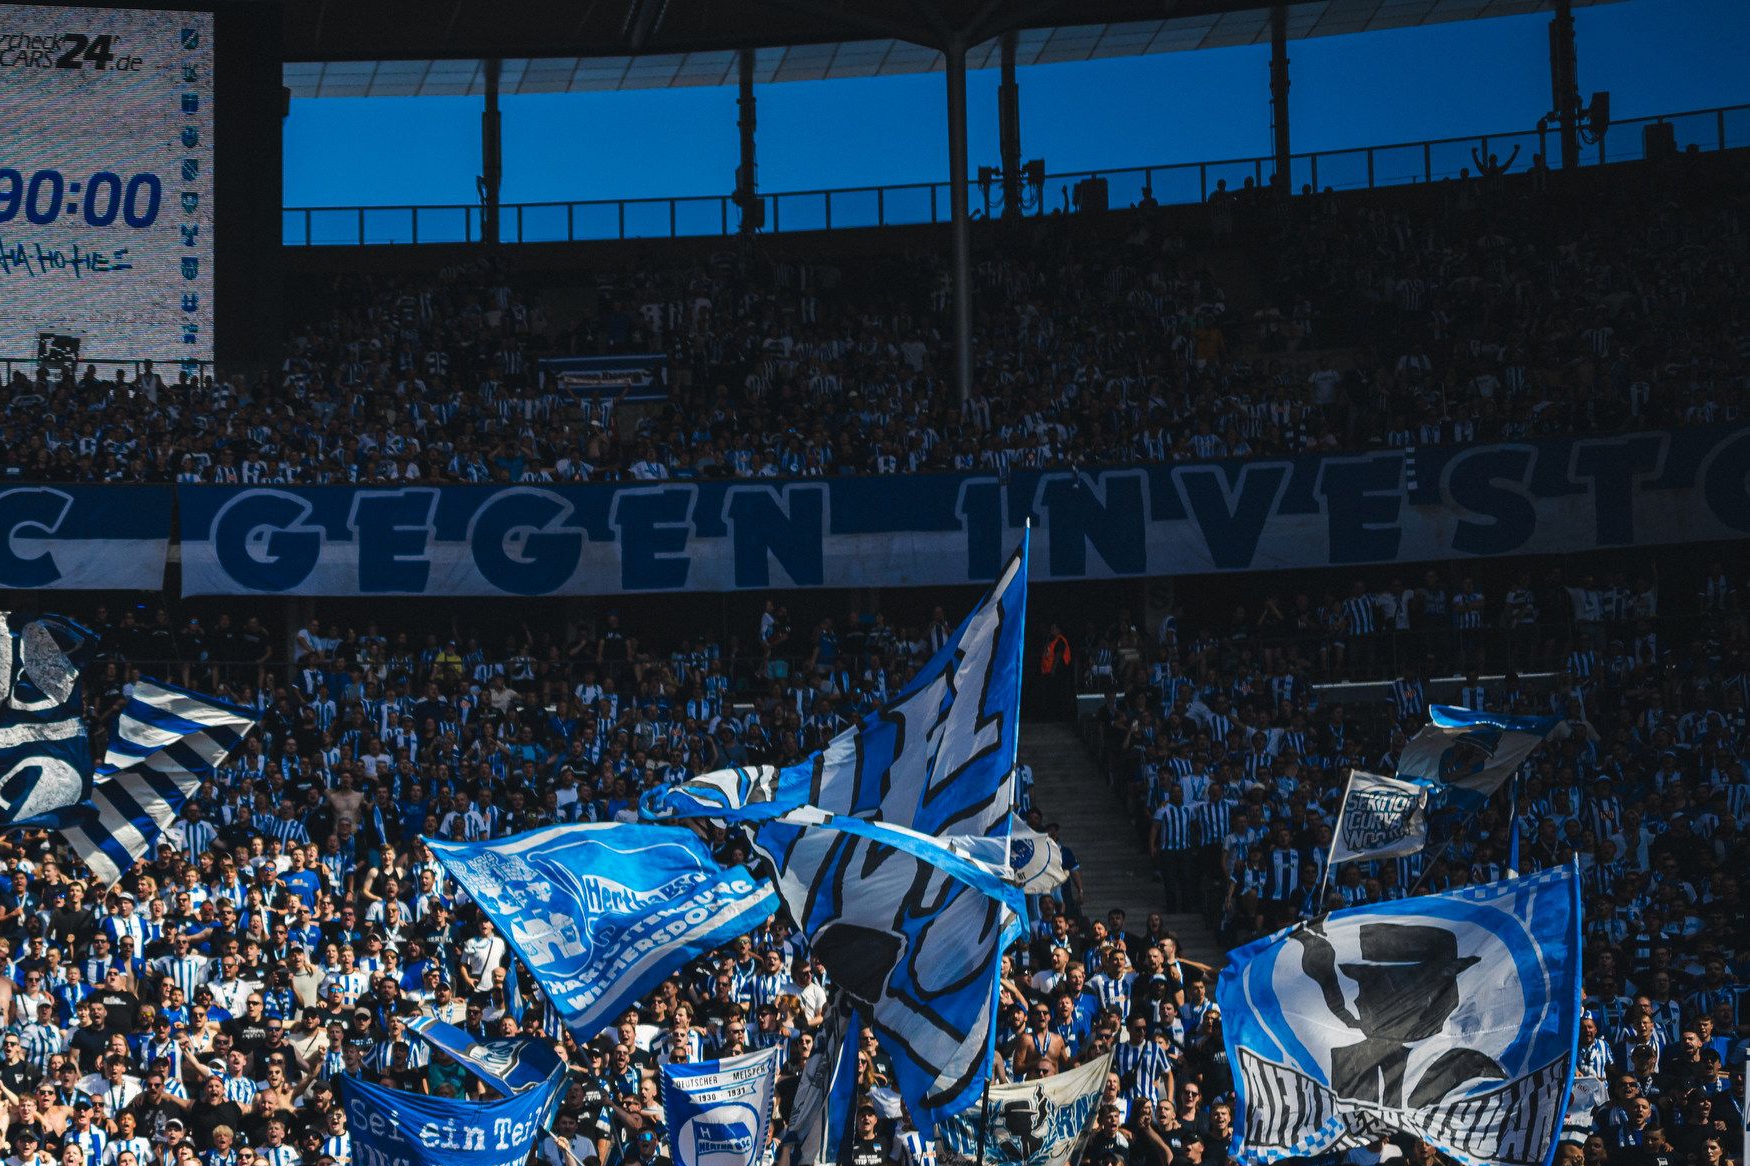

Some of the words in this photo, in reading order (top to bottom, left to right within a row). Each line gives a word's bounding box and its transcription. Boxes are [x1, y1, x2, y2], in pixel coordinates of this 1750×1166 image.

[209, 480, 831, 597] GEGEN
[584, 875, 661, 914] Hertha
[675, 1075, 719, 1089] DEUTSCHER
[732, 1064, 766, 1081] MEISTER
[698, 1093, 717, 1102] 1930
[350, 1098, 405, 1143] Sei
[418, 1116, 486, 1151] ein
[493, 1106, 543, 1151] Teil
